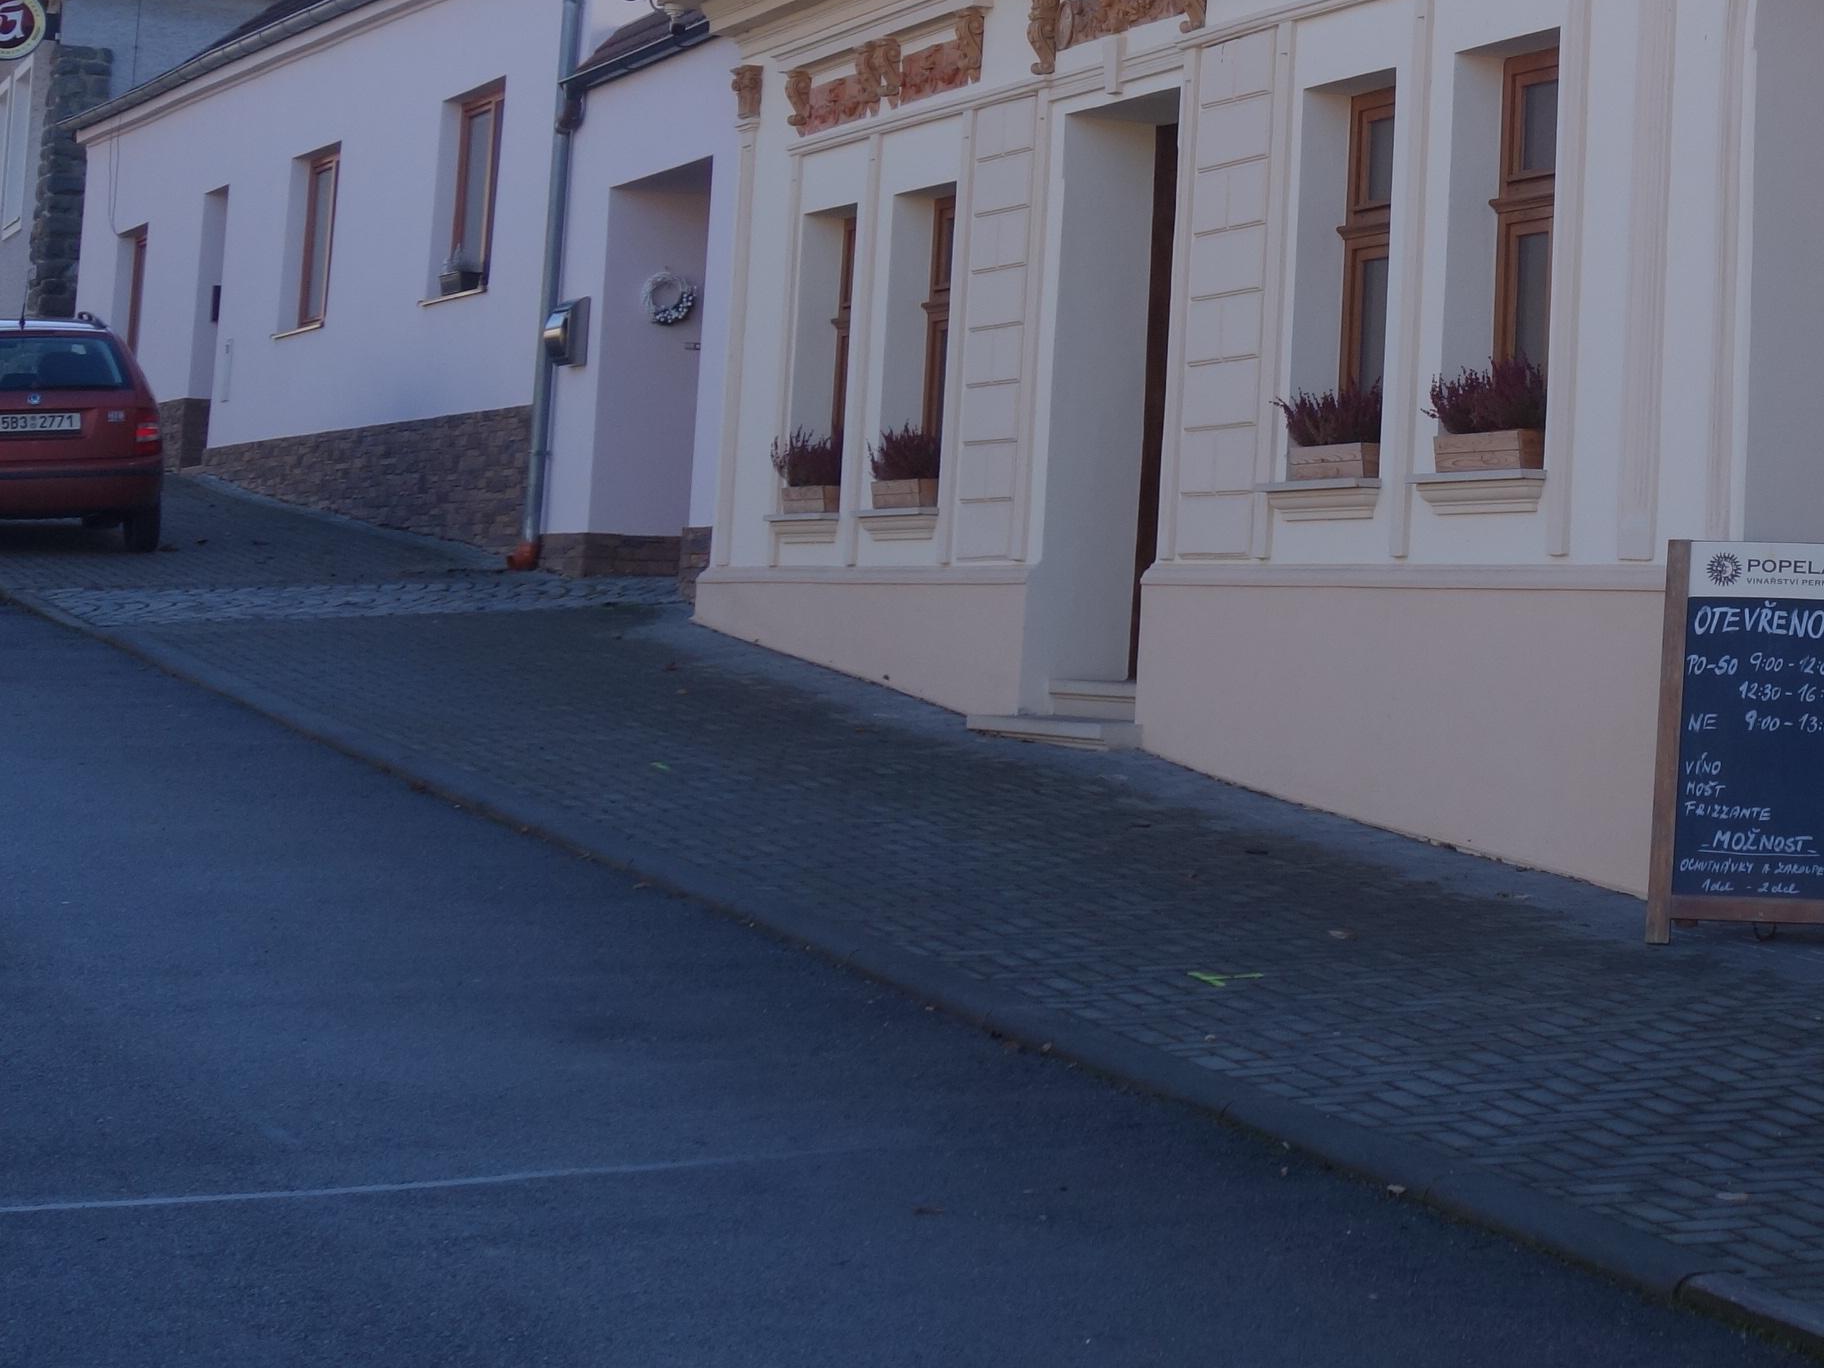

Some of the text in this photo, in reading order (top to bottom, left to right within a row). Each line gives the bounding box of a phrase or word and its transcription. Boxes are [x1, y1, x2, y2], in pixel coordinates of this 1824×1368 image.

[39, 414, 73, 429] 2771
[1746, 576, 1799, 585] VINAŘSTVÍ
[1749, 652, 1784, 672] 9:00
[1738, 680, 1782, 702] 12:30
[1687, 713, 1719, 732] NE
[1744, 709, 1781, 731] 9:00
[1685, 751, 1722, 775] VÍNO
[1686, 780, 1726, 798] MOŠT
[1684, 800, 1771, 821] FRIZZANTE
